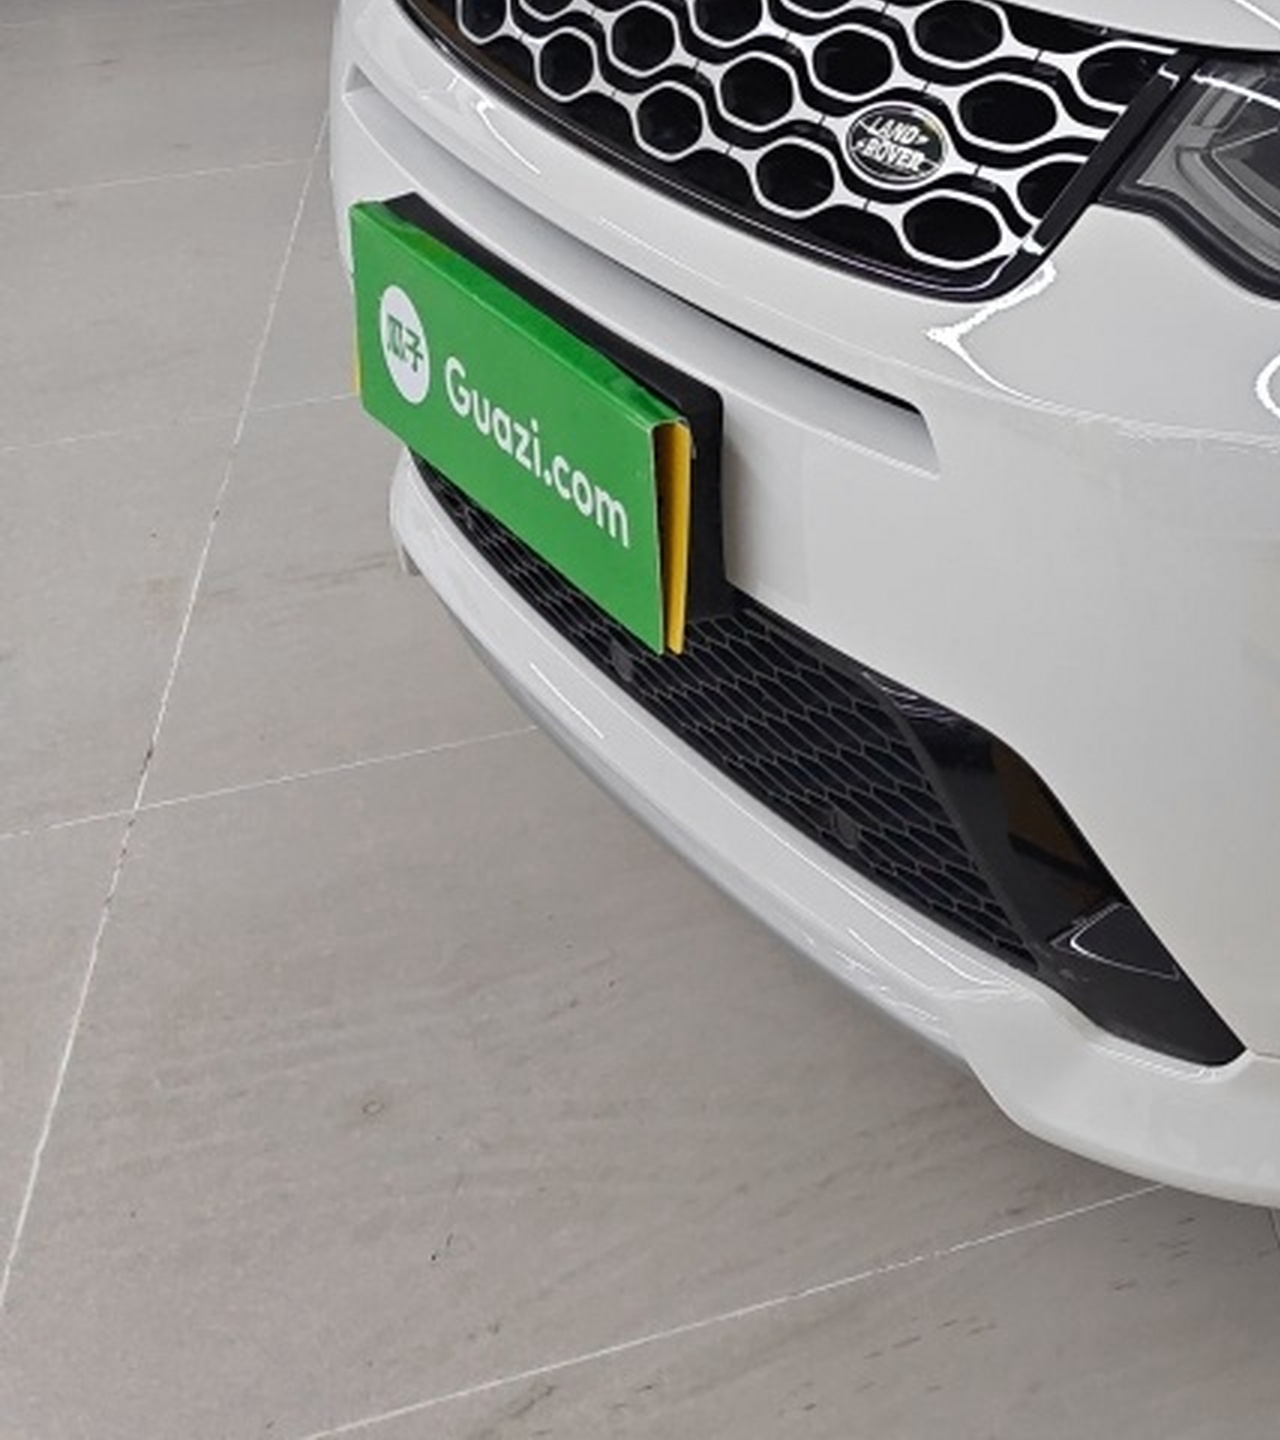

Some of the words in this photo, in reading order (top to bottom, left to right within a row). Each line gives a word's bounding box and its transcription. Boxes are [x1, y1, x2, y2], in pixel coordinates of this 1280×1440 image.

[871, 116, 921, 145] LAND
[863, 138, 926, 172] ROVER
[445, 356, 630, 550] Guazi.com
